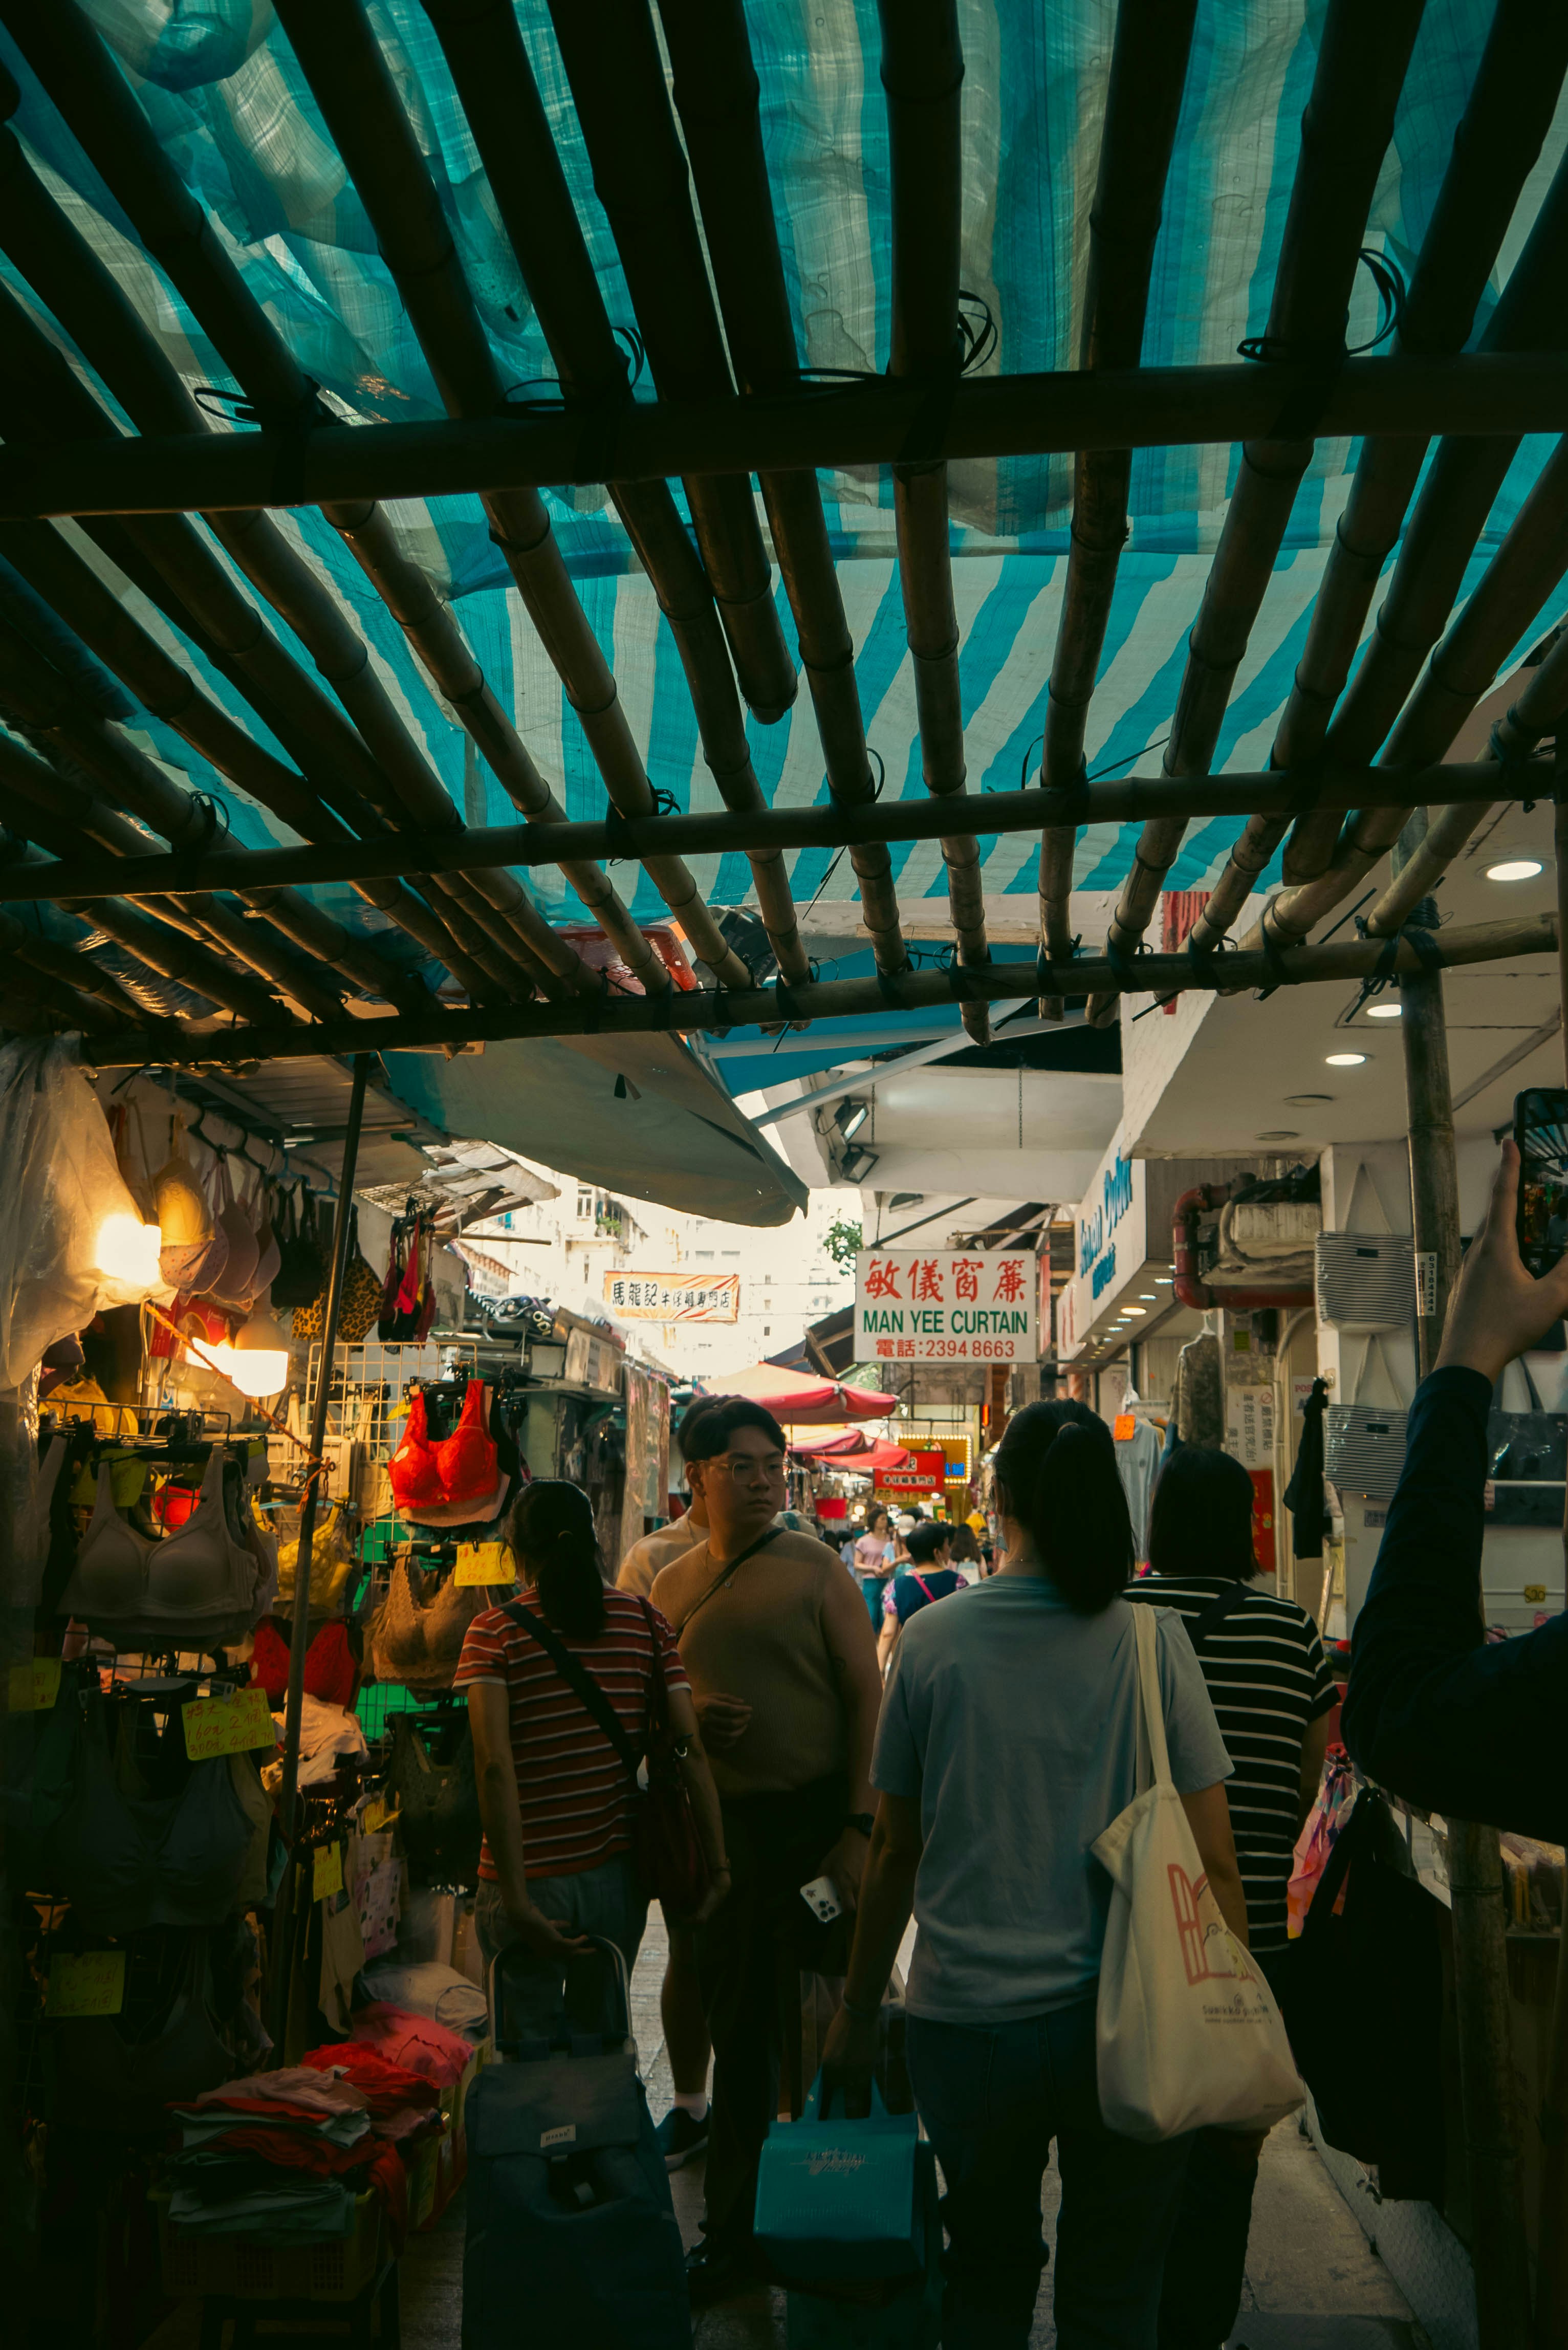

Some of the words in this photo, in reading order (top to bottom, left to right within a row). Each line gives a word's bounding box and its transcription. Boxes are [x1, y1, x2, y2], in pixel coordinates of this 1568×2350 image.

[863, 1310, 904, 1334] MAN
[910, 1310, 944, 1334] YEE
[951, 1310, 1028, 1334] CURTAIN
[972, 1340, 1015, 1357] 8663
[1295, 1384, 1312, 1392] POS
